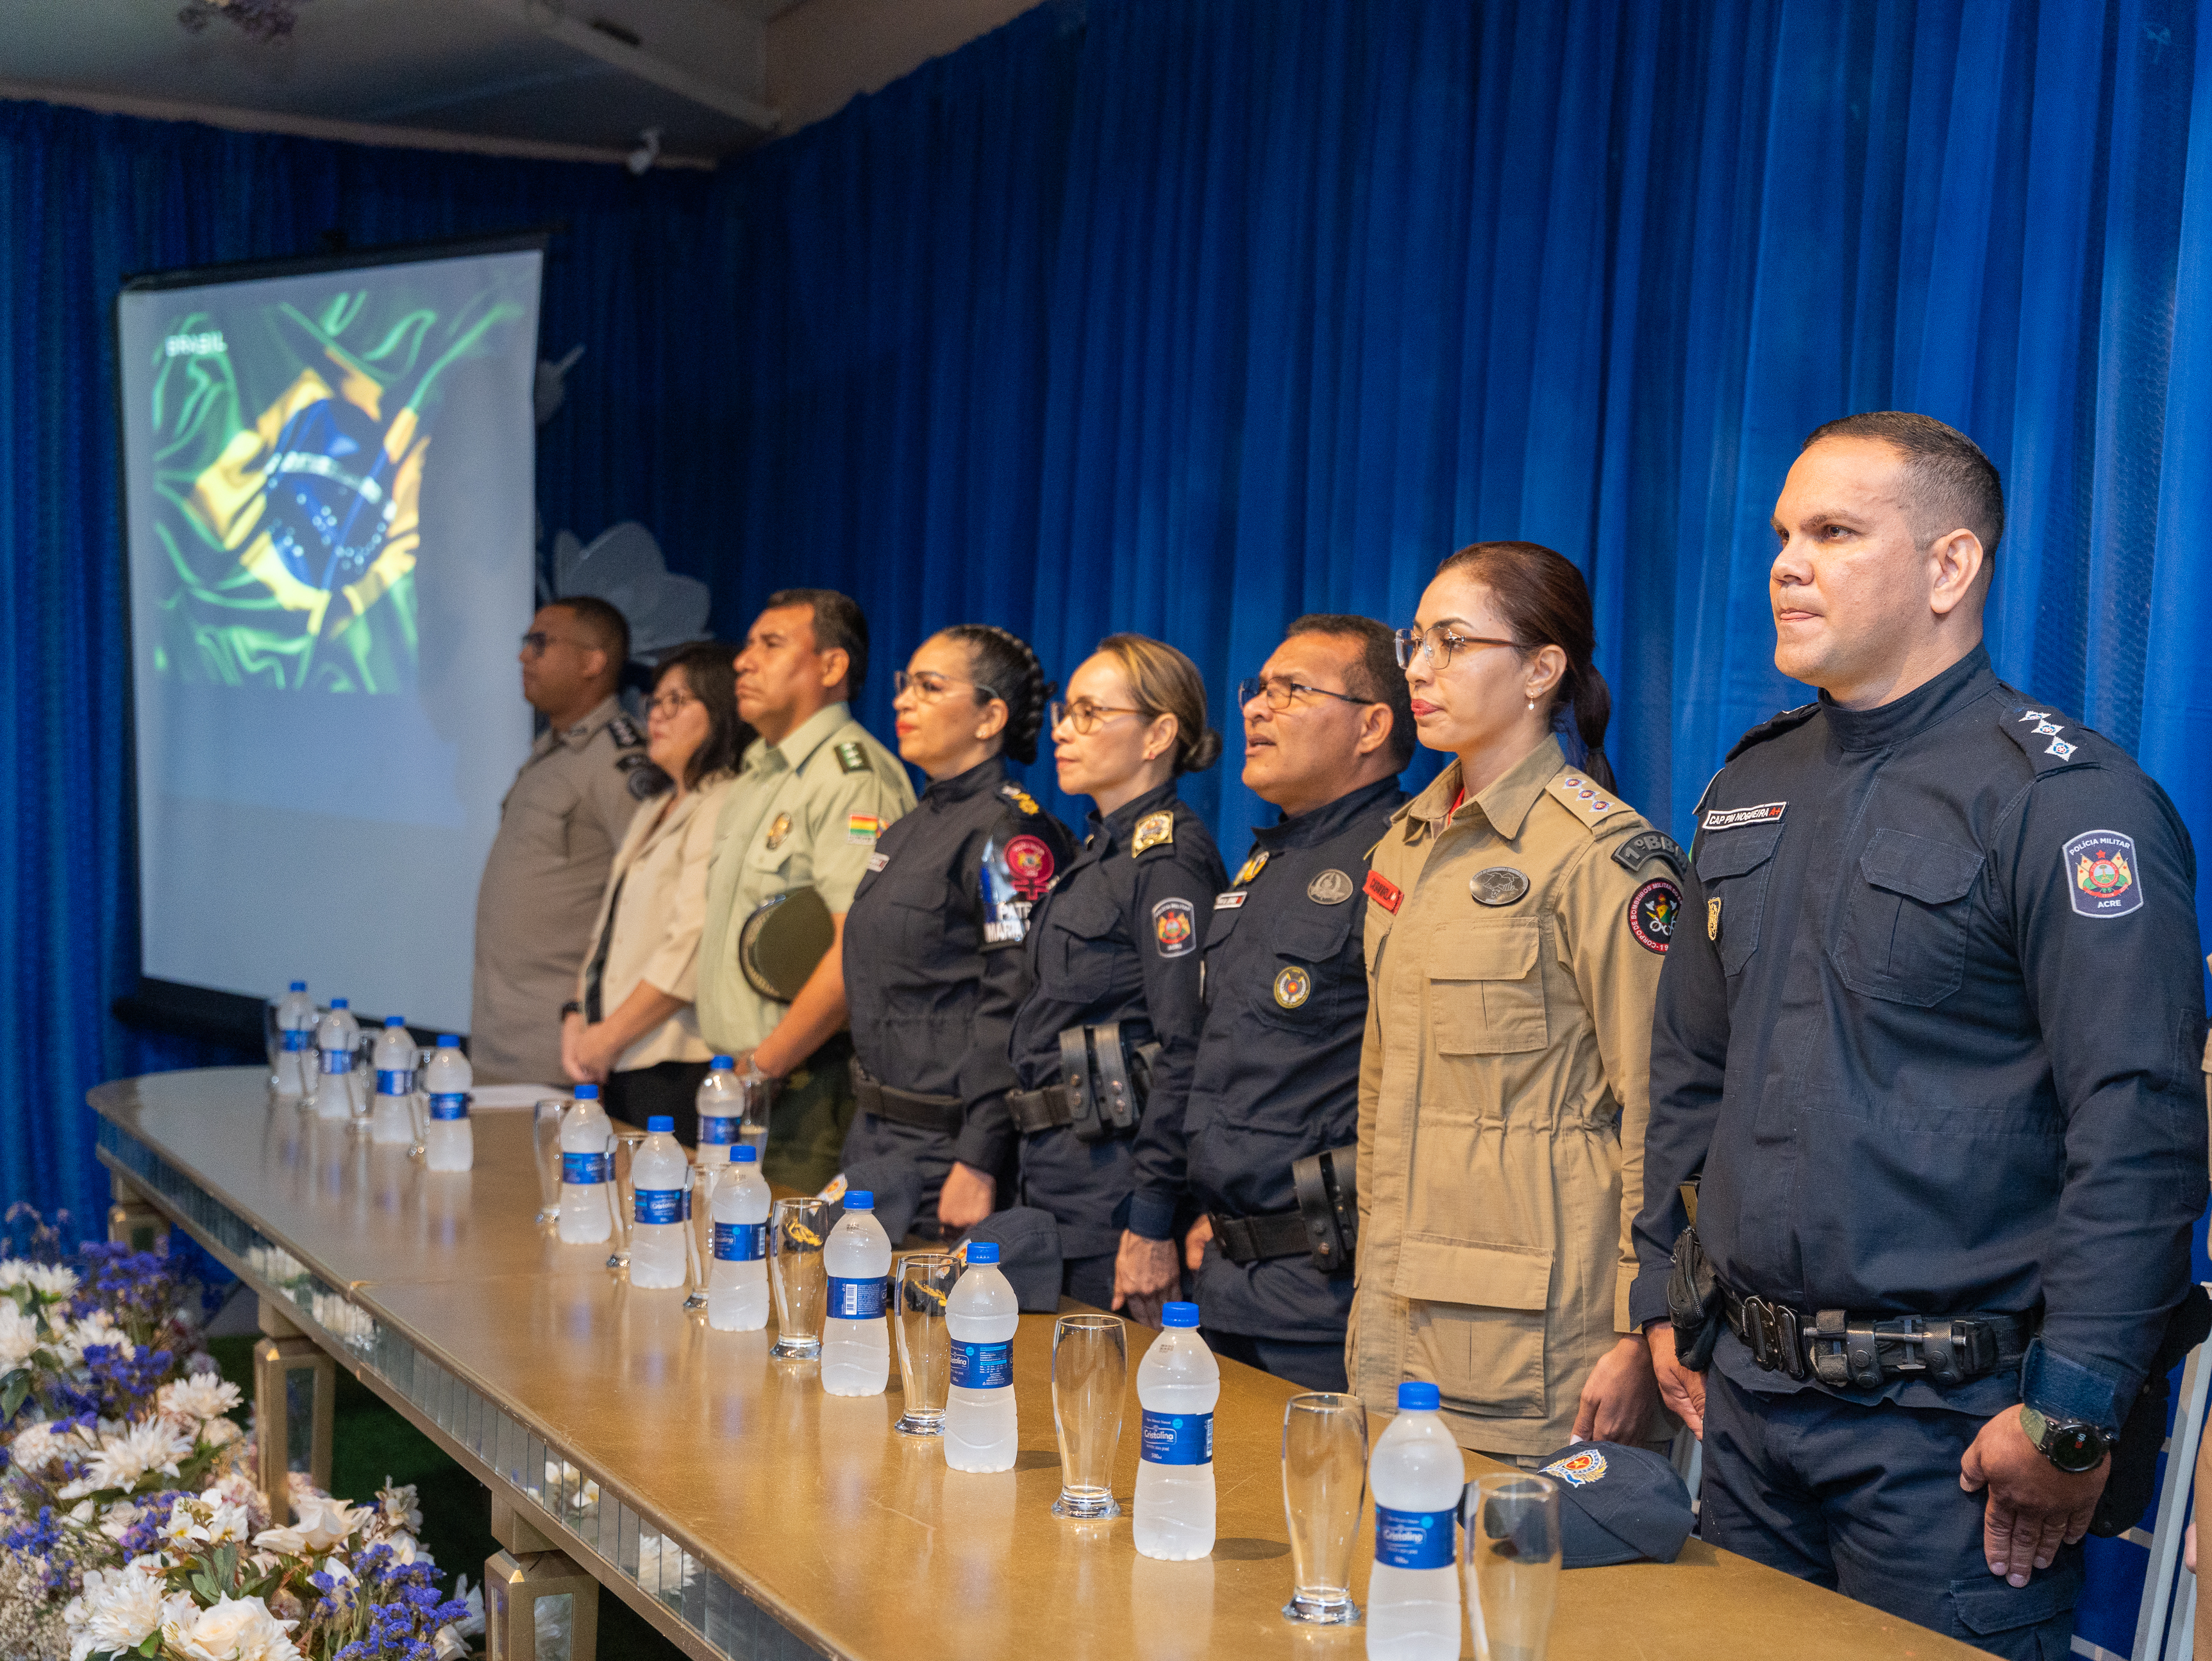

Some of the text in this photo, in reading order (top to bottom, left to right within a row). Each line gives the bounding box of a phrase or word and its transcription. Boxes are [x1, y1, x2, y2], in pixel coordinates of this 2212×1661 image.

[1709, 815, 1725, 825] CAP
[1735, 808, 1770, 822] NOGUEIRA
[1769, 807, 1781, 816] A+
[2069, 838, 2131, 856] POLÍCIA MILITAR
[1652, 882, 1672, 891] MILITAR
[1631, 886, 1652, 920] BOMBEIROS
[2097, 900, 2122, 908] ACRE
[1632, 921, 1639, 930] DE
[1636, 930, 1656, 948] CORPO
[1144, 1429, 1174, 1440] Cristalina
